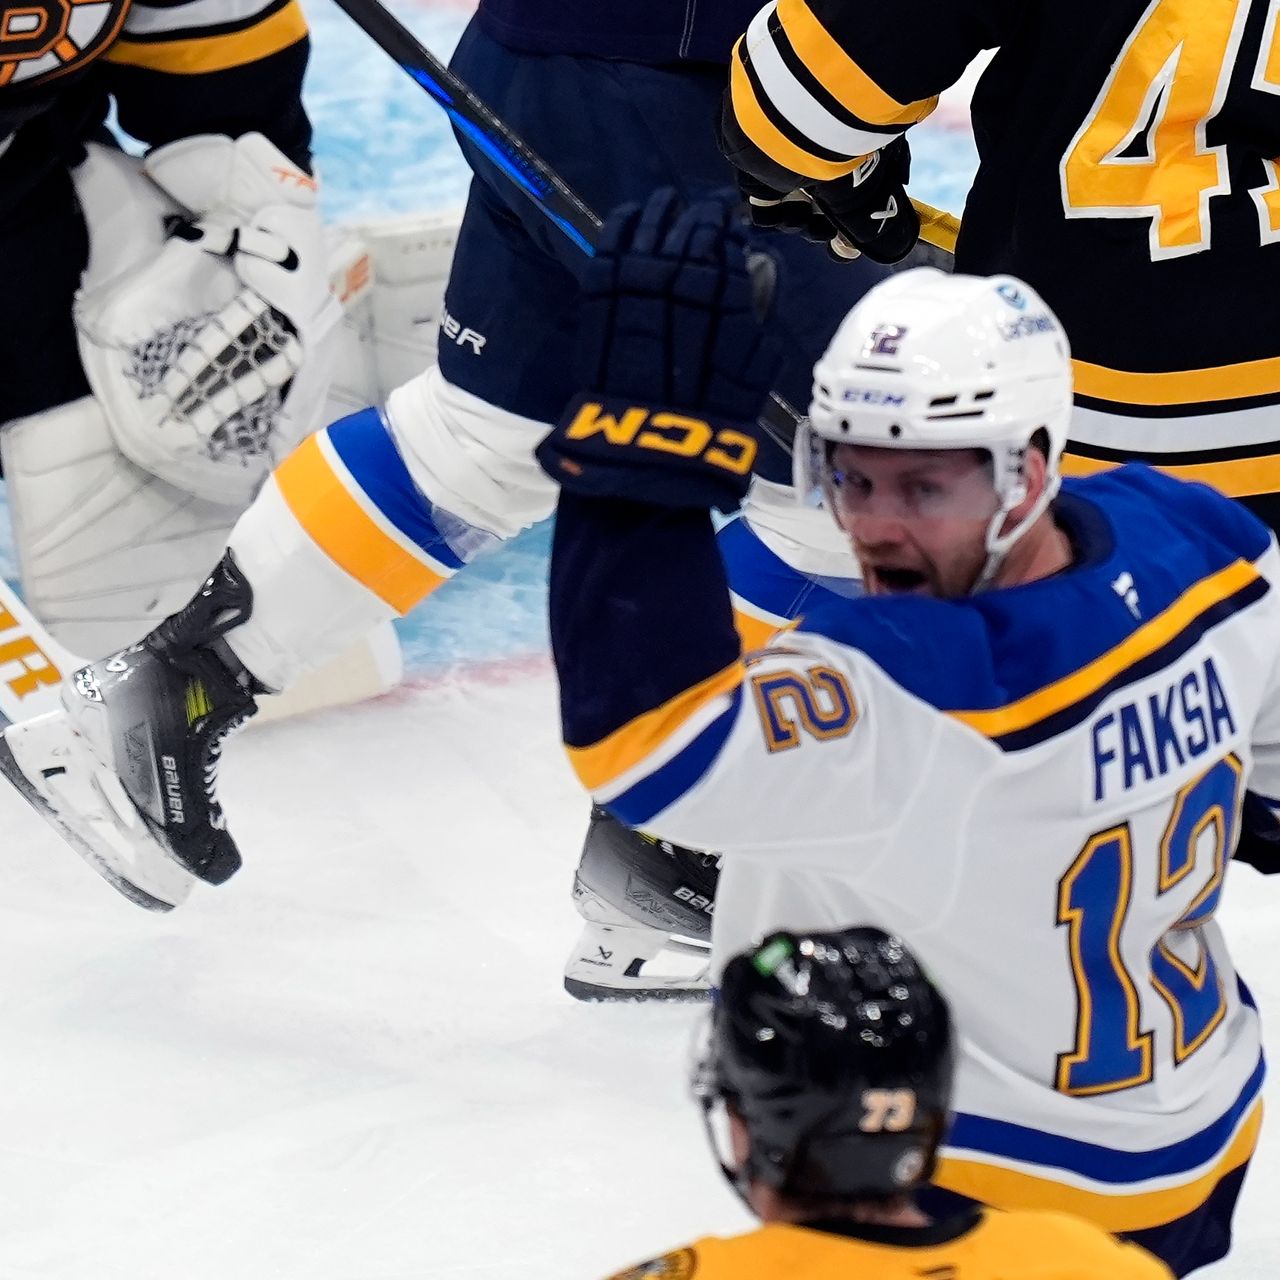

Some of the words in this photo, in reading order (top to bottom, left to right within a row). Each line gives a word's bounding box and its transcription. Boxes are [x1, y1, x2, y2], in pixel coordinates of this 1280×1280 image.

[564, 400, 759, 476] CCM
[1090, 658, 1238, 802] FAKSA
[160, 754, 186, 825] BAUER
[1053, 751, 1245, 1098] 12
